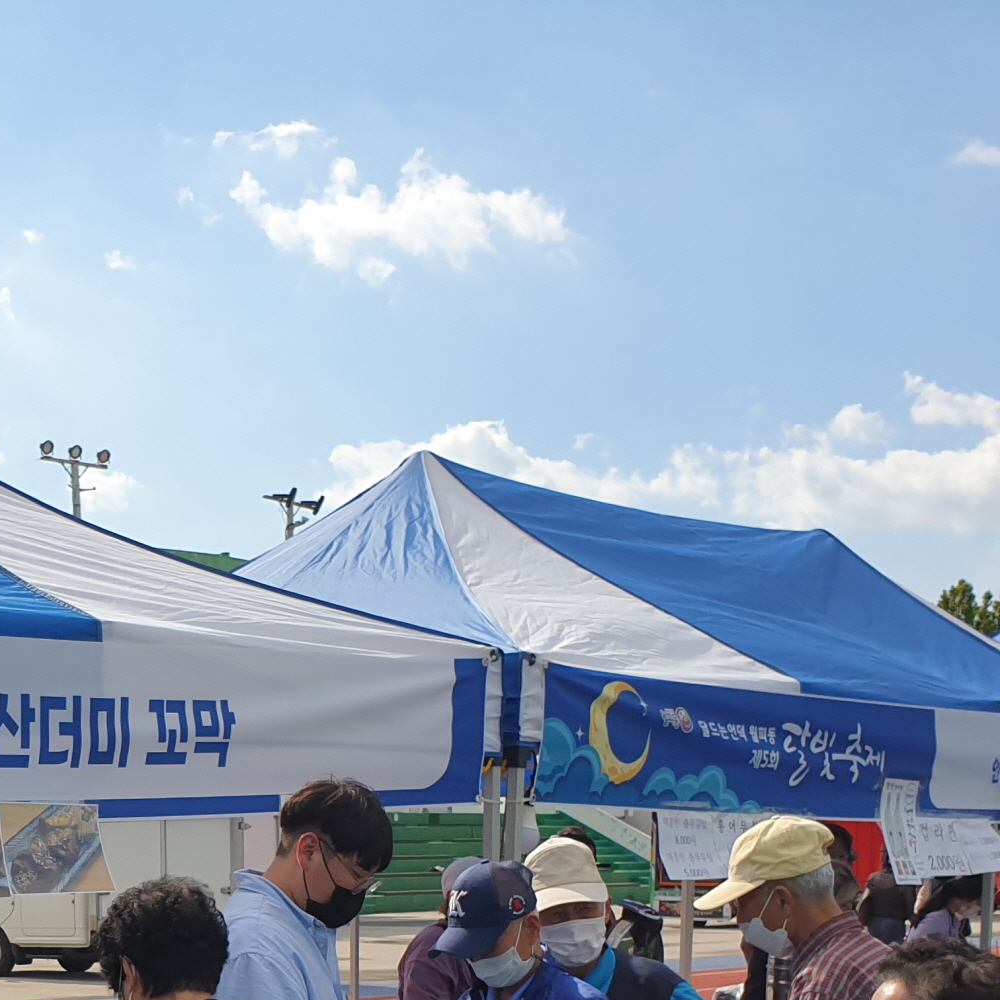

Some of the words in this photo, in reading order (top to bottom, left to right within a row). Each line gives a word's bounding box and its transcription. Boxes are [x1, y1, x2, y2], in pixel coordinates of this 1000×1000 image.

[145, 699, 236, 767] 꼬막
[749, 724, 777, 745] 월피동
[749, 749, 780, 770] 제5회
[927, 854, 967, 873] 2,000원
[448, 889, 468, 917] K
